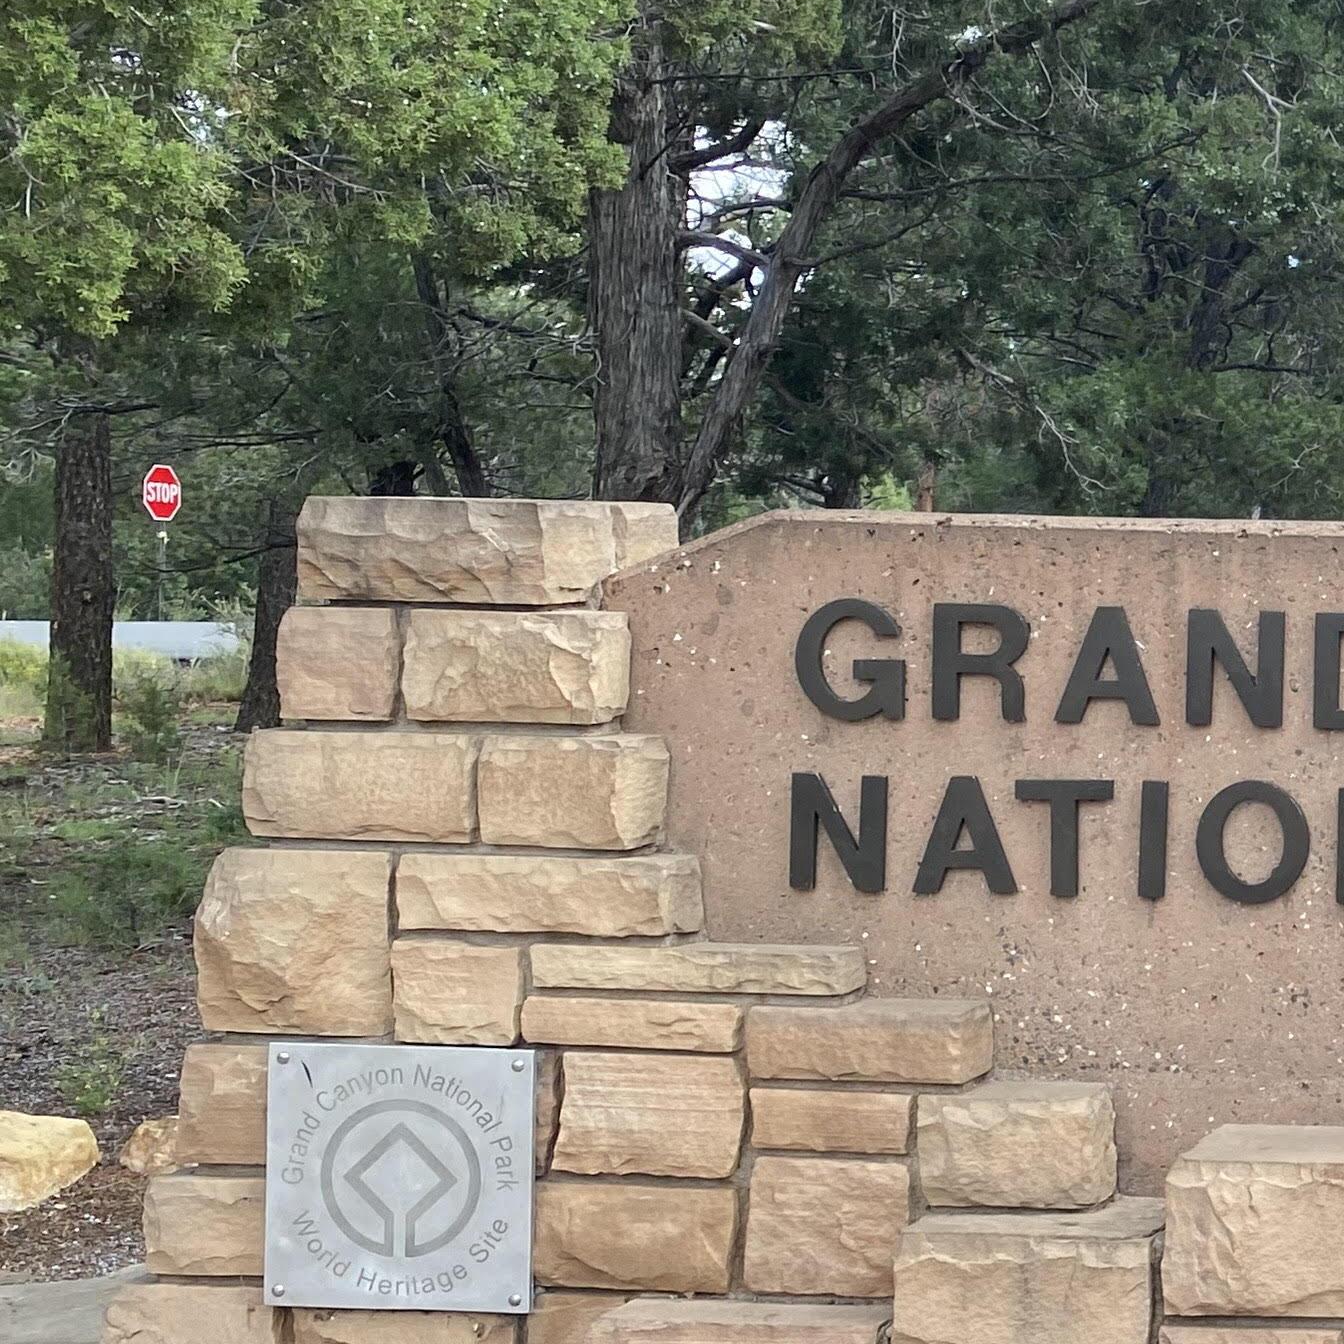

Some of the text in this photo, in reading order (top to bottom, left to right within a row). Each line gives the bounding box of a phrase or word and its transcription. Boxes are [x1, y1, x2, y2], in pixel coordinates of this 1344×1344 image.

[147, 482, 177, 503] STOP
[281, 1064, 520, 1192] Grand Canyon National Park
[293, 1210, 509, 1296] World Heritage Site
